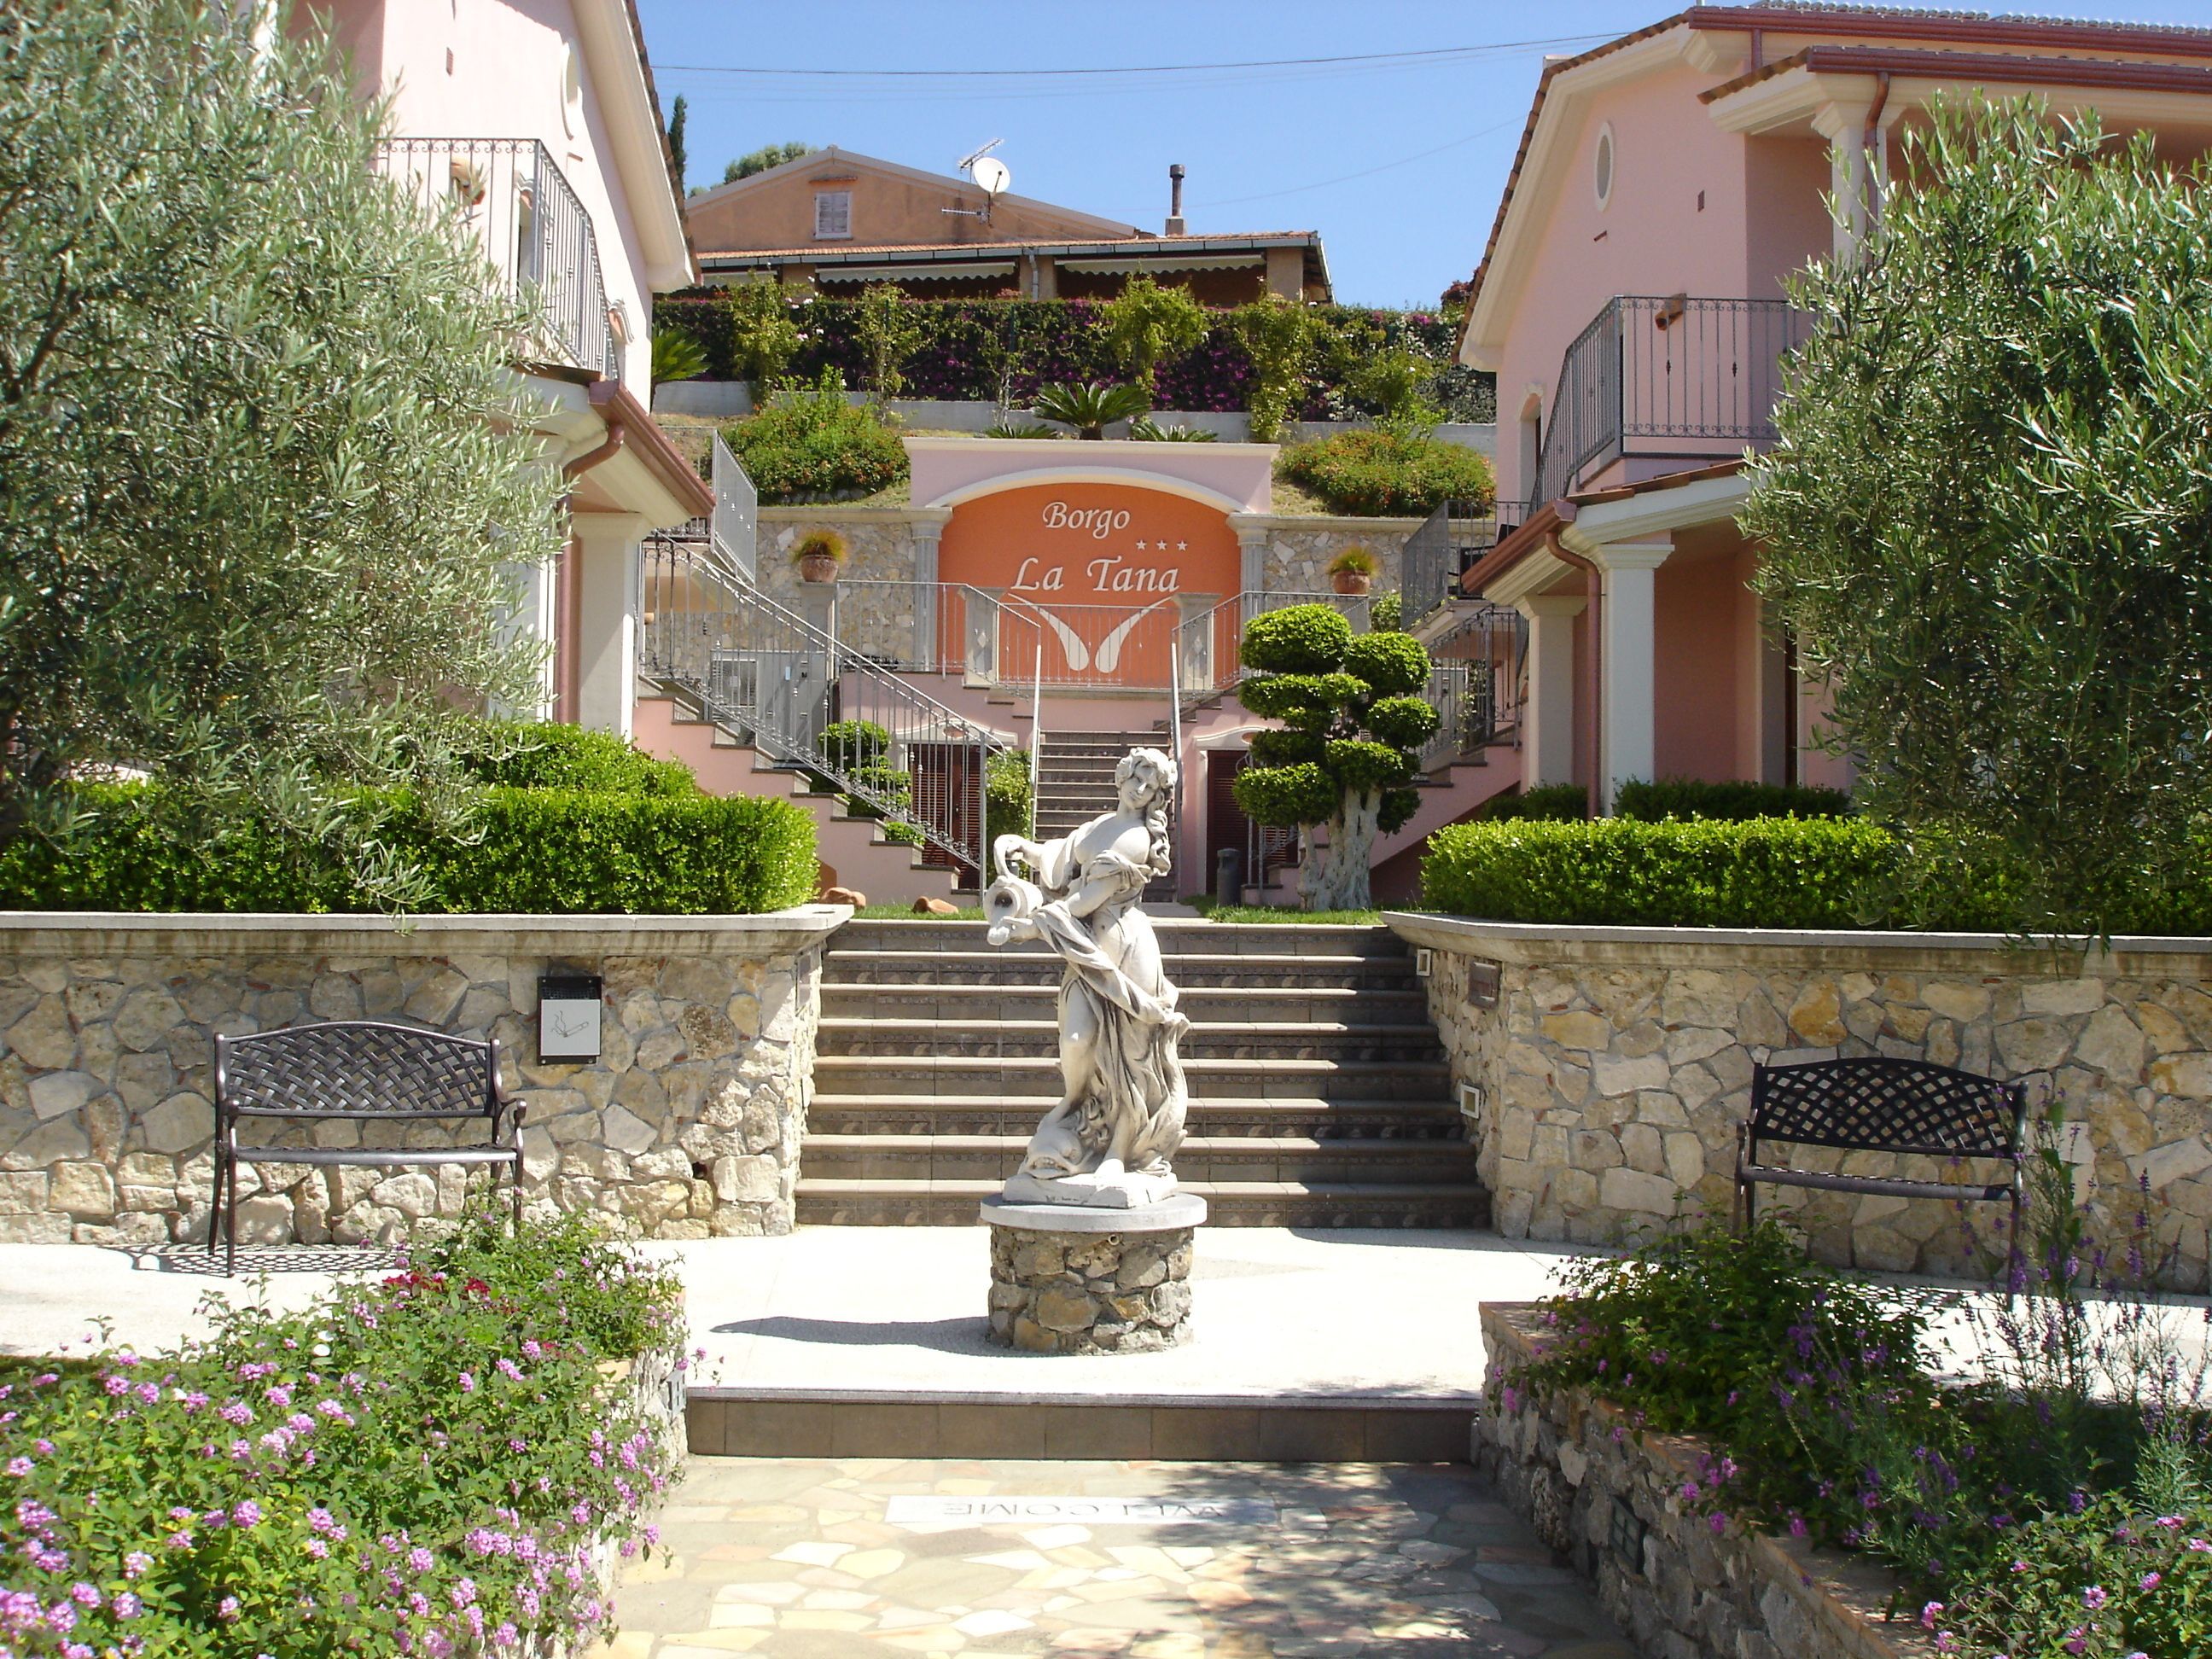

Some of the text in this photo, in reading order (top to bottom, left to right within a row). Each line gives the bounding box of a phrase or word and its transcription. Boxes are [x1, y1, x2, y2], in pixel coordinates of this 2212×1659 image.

[1042, 501, 1131, 539] Borgo
[1010, 556, 1179, 592] La Tana
